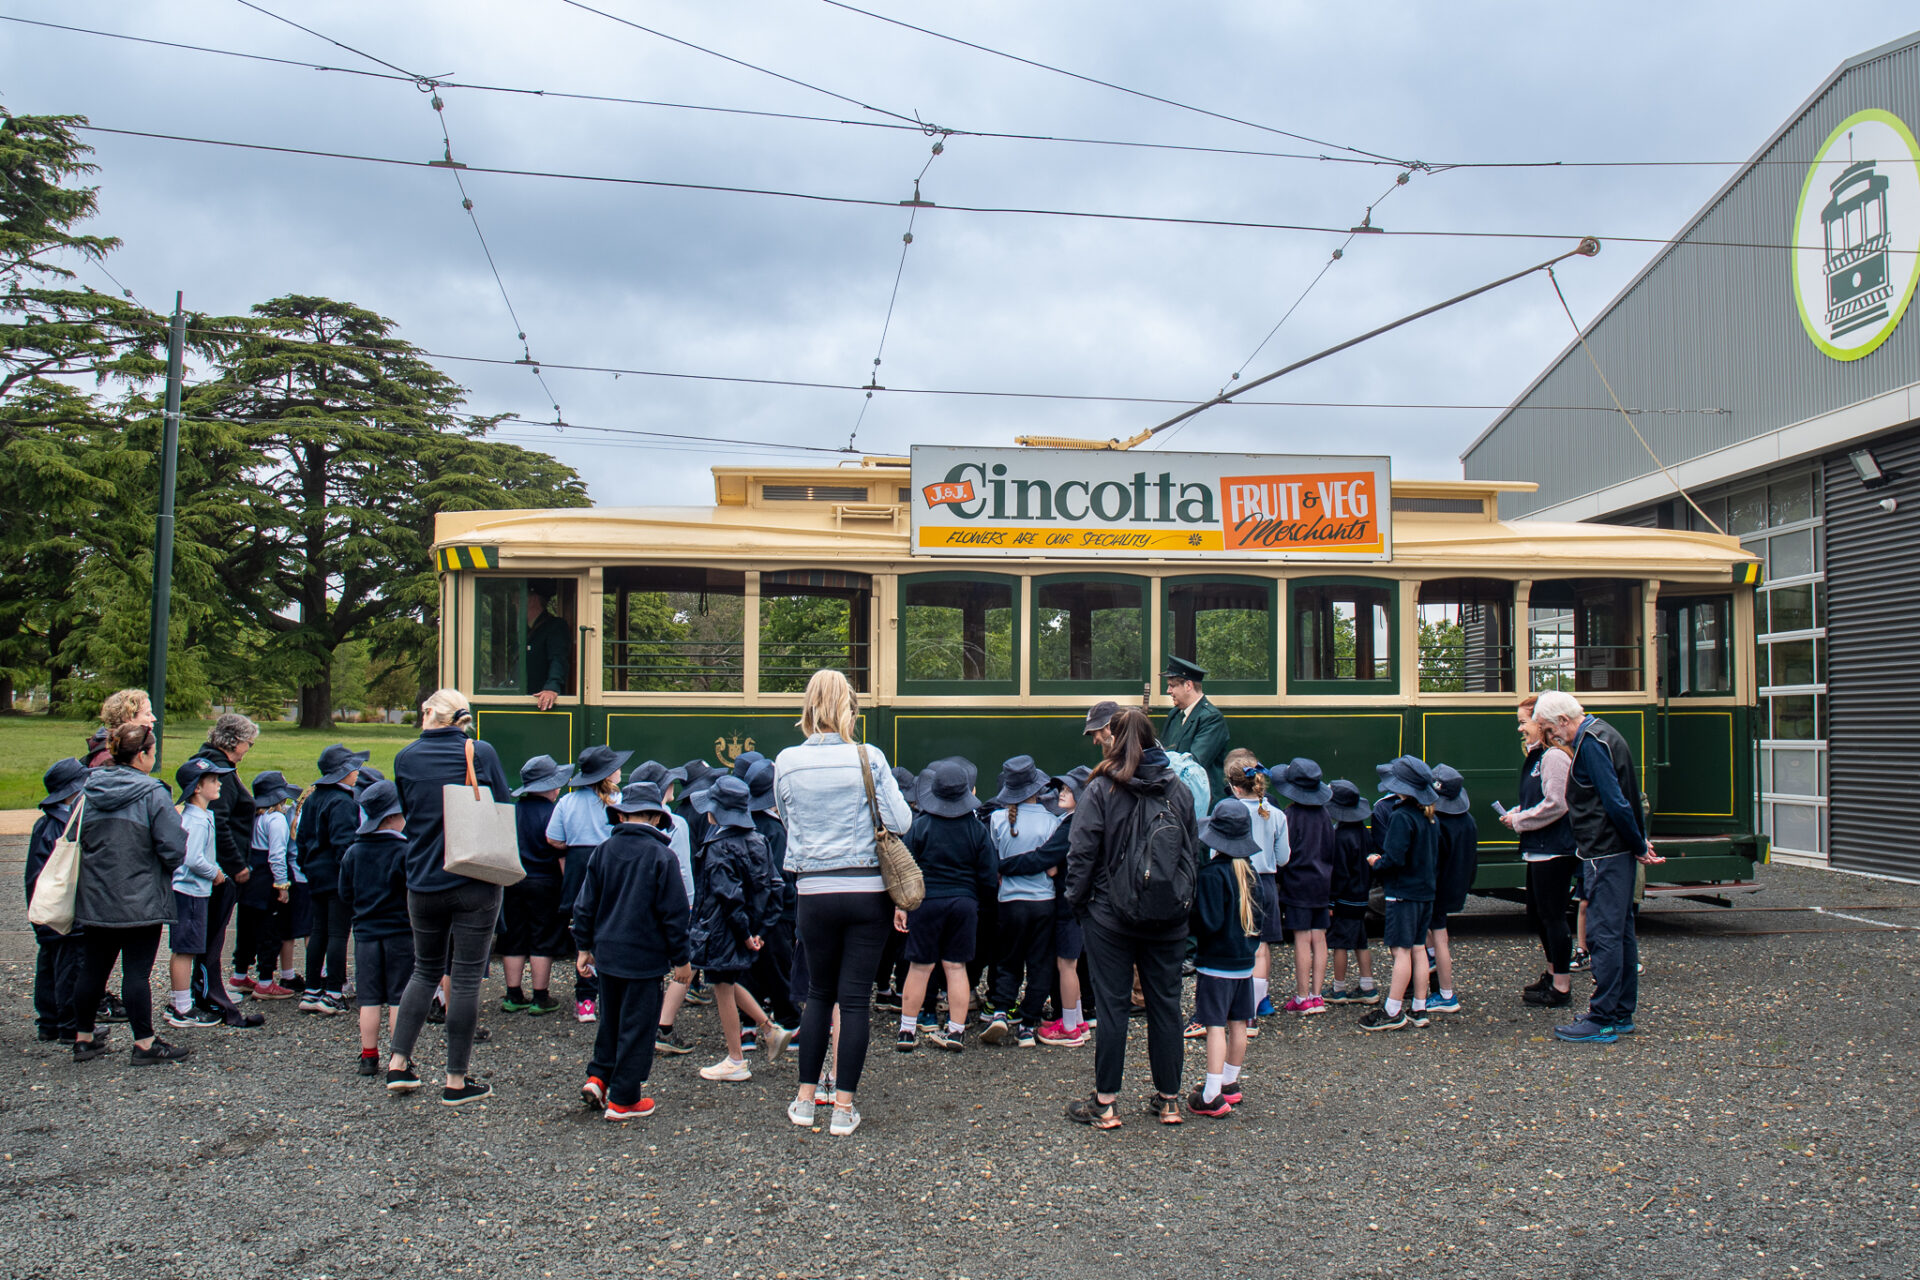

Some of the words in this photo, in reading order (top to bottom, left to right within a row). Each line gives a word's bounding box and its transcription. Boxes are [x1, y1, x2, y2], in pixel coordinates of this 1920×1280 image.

[943, 462, 1220, 523] Cincotta
[1230, 483, 1303, 523] FRUIT
[1302, 491, 1320, 509] &
[1317, 479, 1369, 519] VEG
[946, 530, 1008, 545] FLOWERS
[1012, 532, 1039, 545] ARE
[1045, 532, 1074, 545] OUR
[1080, 531, 1152, 548] SPECIALITY
[1234, 512, 1371, 546] Merchants
